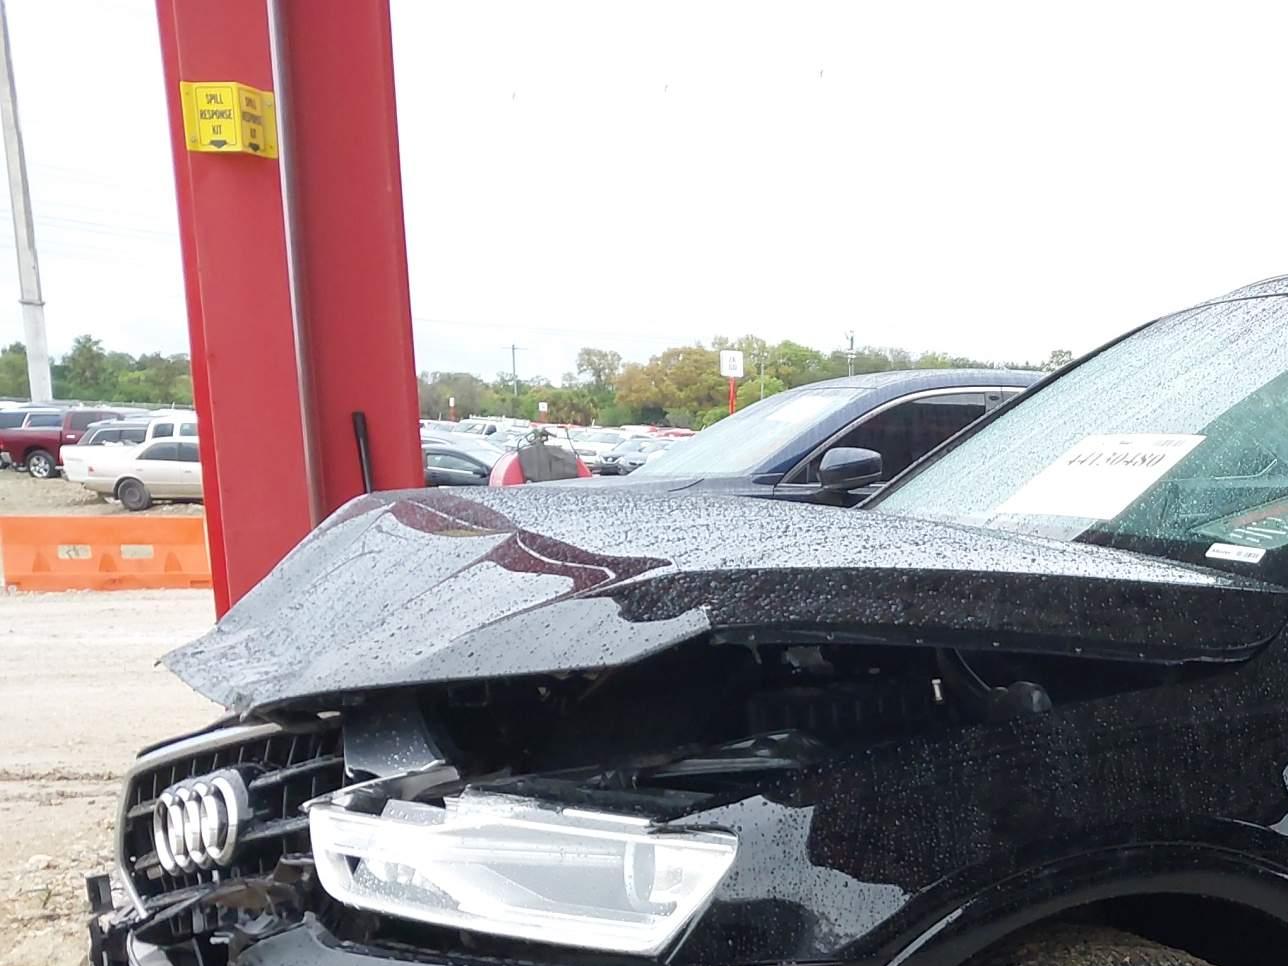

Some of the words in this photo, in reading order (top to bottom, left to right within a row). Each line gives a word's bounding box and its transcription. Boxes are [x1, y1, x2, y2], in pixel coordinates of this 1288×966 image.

[205, 93, 224, 105] SPILL
[199, 108, 233, 120] RESPONSE
[211, 124, 222, 136] KIT
